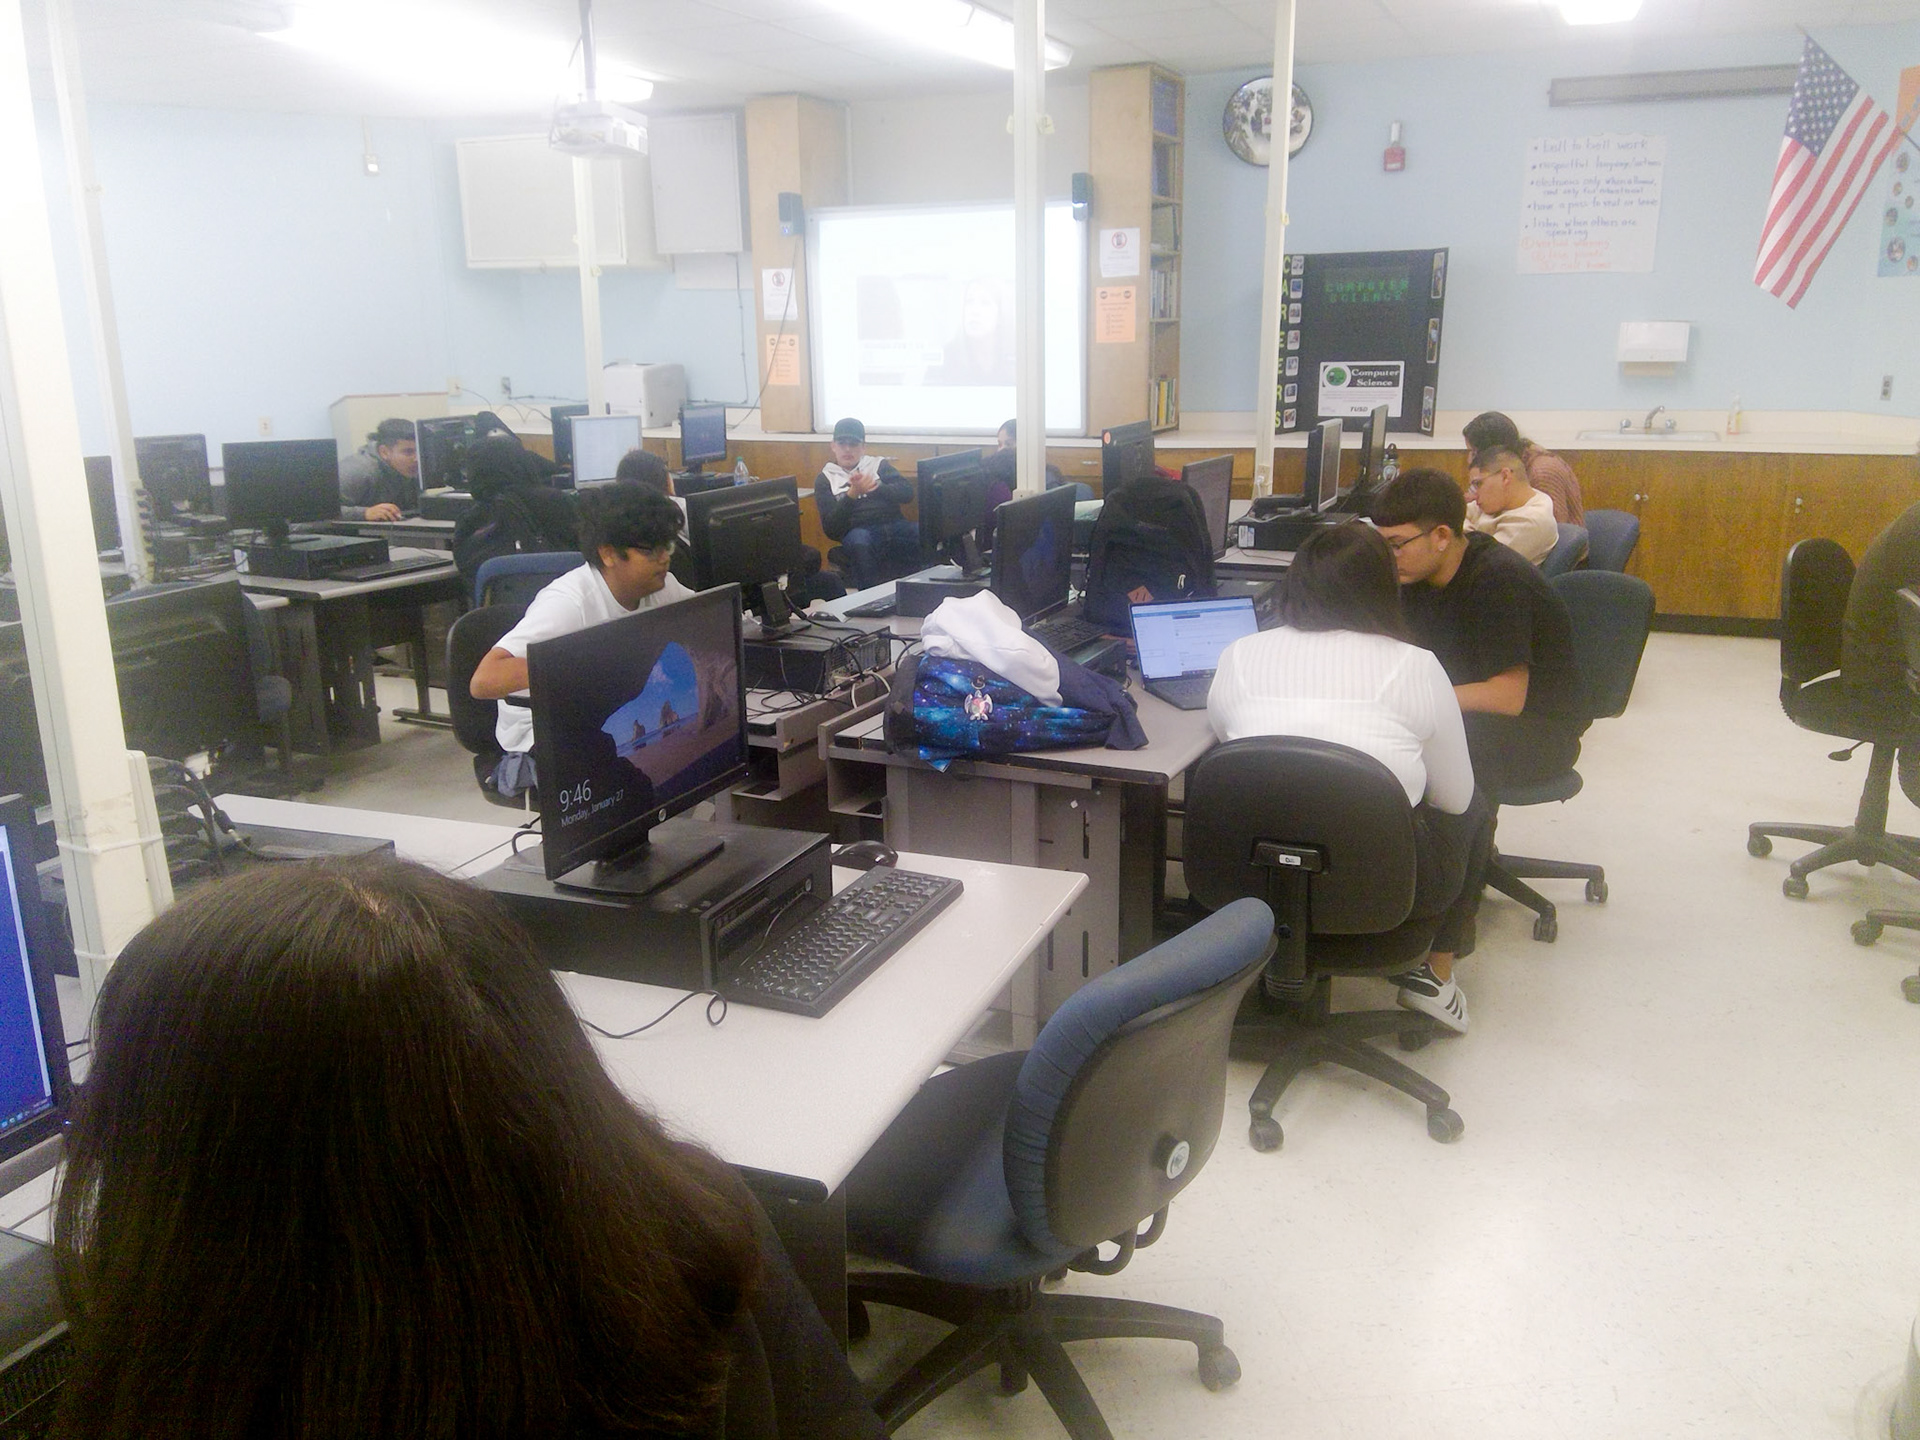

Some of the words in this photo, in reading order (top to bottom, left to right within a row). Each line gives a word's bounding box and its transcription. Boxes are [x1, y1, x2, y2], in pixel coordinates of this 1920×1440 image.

[1617, 139, 1648, 150] work
[1583, 176, 1600, 189] only
[1565, 216, 1588, 227] when
[1324, 278, 1409, 293] COMPUTER
[1330, 292, 1402, 303] SCIENCE
[1351, 368, 1400, 378] Computer
[1356, 378, 1393, 387] Science
[560, 779, 592, 812] 9:46
[591, 796, 615, 813] January
